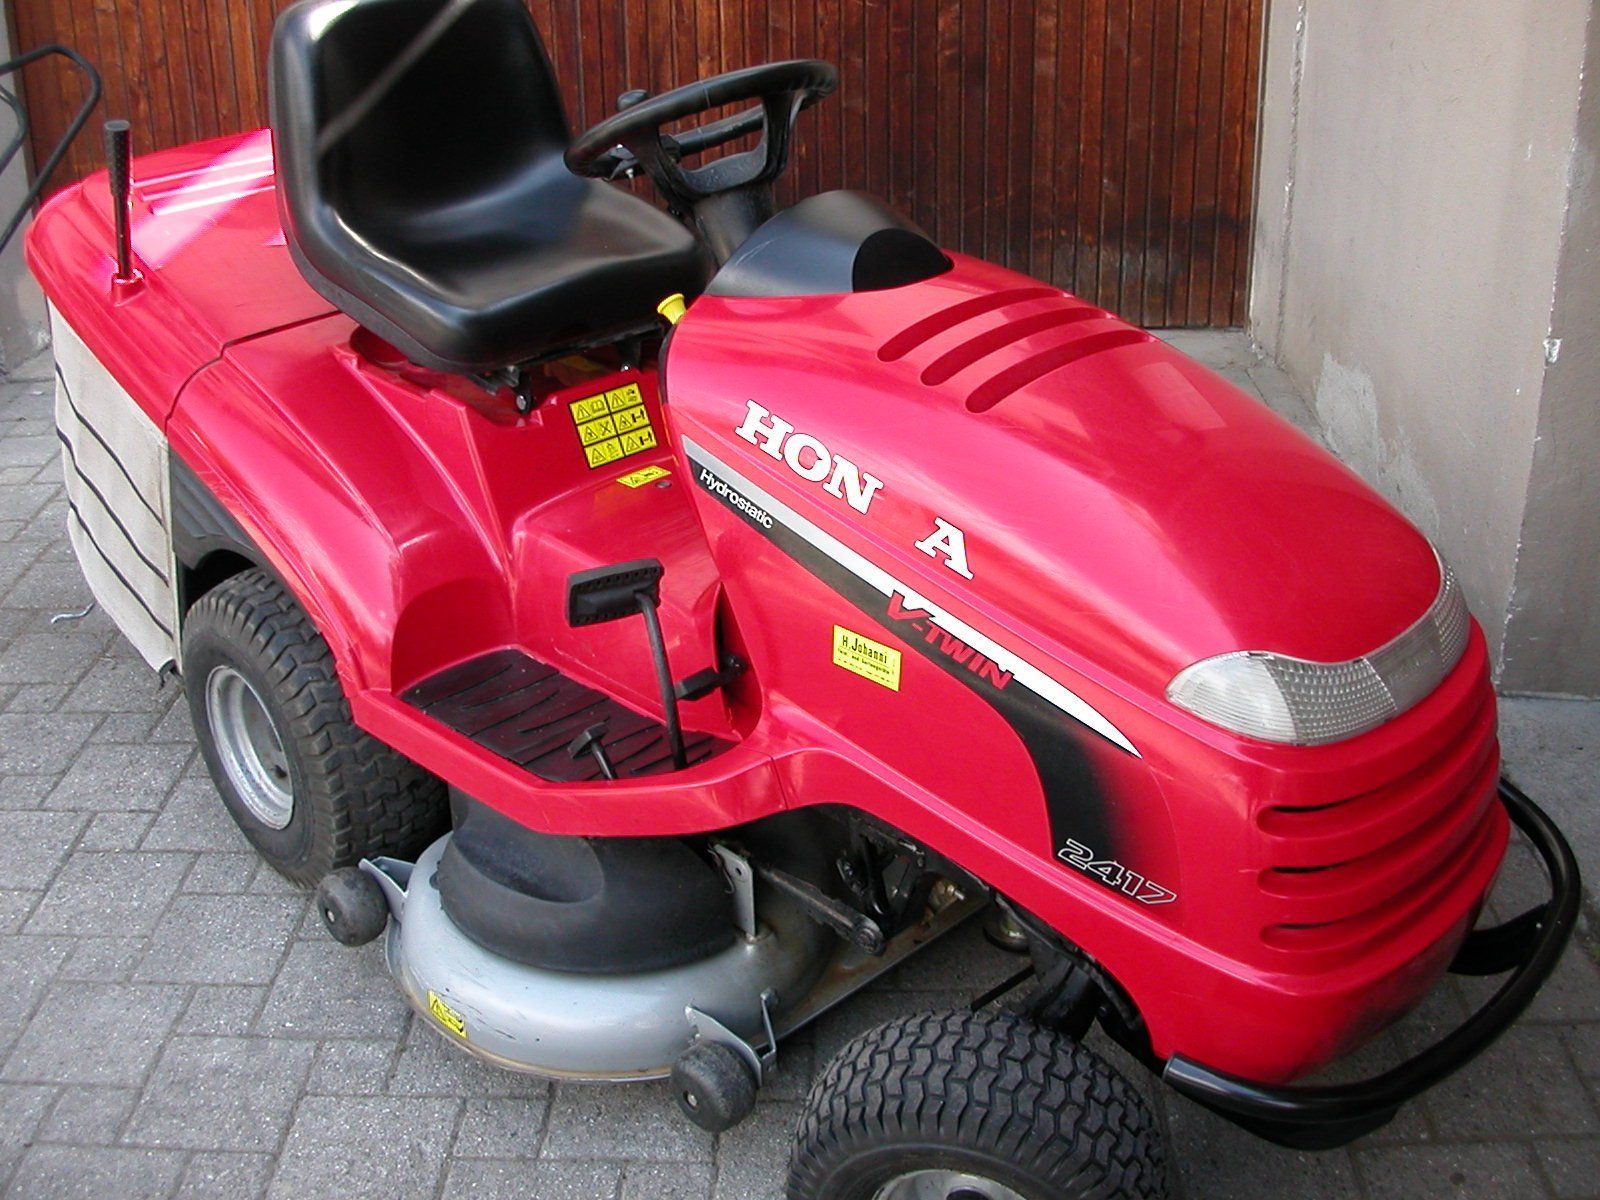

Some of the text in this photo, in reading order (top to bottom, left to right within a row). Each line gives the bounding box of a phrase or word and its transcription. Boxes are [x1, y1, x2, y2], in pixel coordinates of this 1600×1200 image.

[700, 469, 773, 529] Hydrostatic
[886, 590, 1014, 690] V-TWIN
[1058, 838, 1177, 905] 2417
